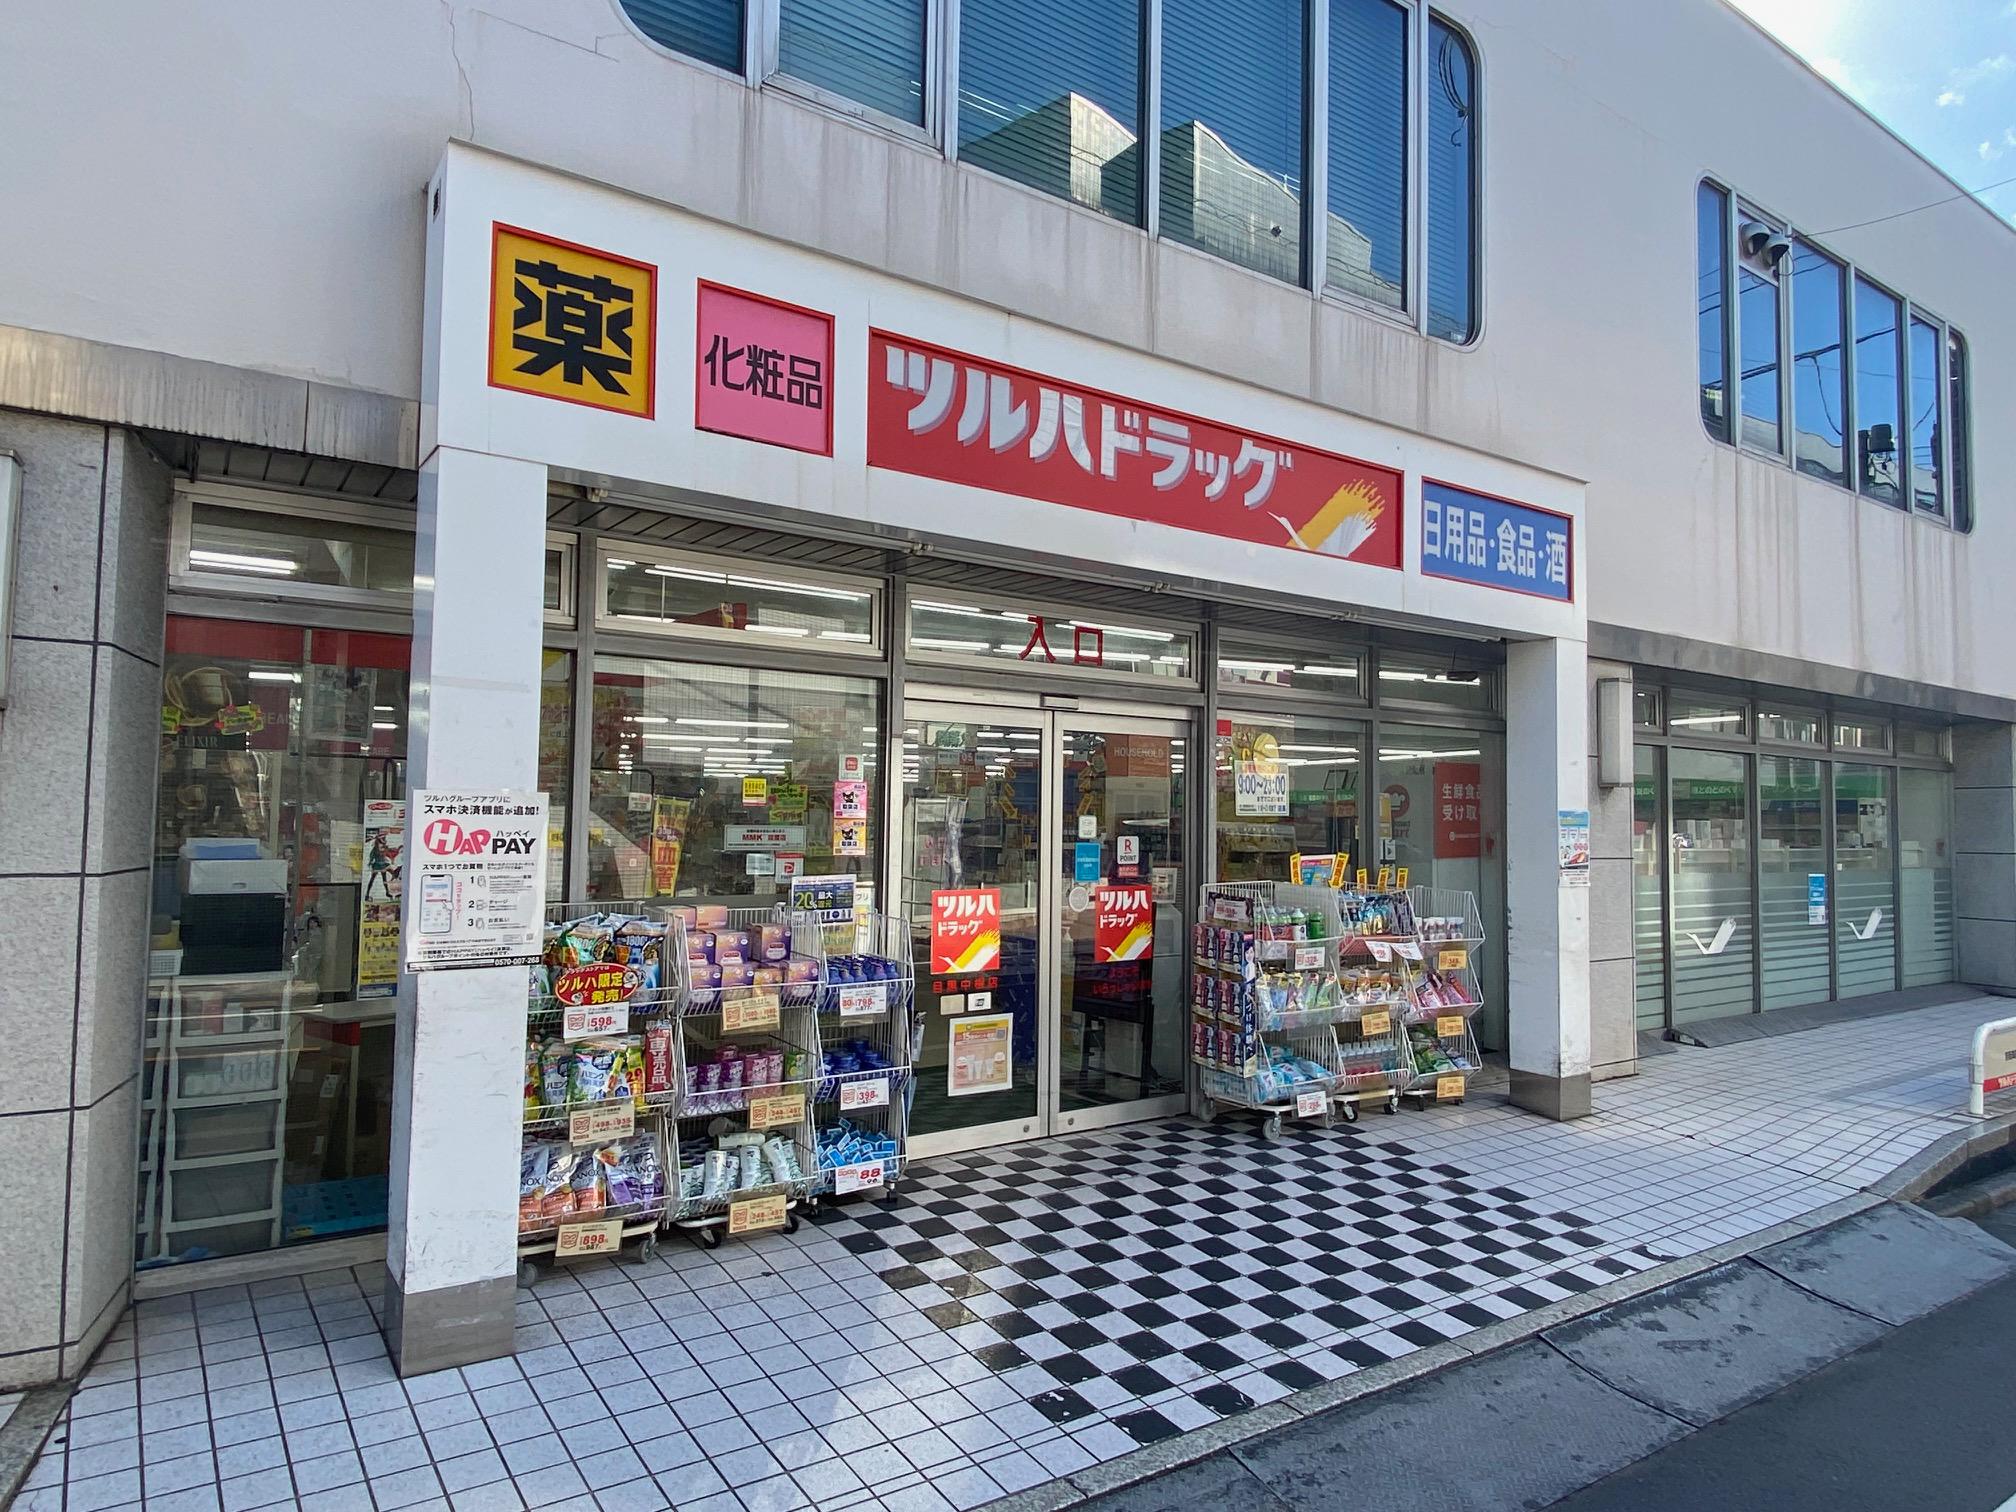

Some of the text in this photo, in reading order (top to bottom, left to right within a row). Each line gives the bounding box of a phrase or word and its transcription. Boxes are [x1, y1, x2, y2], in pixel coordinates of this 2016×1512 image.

[512, 258, 633, 396] 薬
[703, 334, 823, 410] 化粧品
[885, 345, 1294, 509] ツルハドラッグ
[1423, 500, 1567, 585] 日用品・食品・酒
[1018, 614, 1103, 667] 入口
[1114, 746, 1164, 759] HOUSEHOLD
[1124, 839, 1132, 852] R
[468, 900, 475, 908] 2
[937, 894, 996, 918] ツルハ
[1100, 890, 1149, 912] ツルハ
[467, 919, 474, 927] 3
[938, 919, 984, 936] ドラッグ
[1100, 913, 1138, 928] ドラッグ
[494, 956, 540, 966] 0570-007-268
[558, 972, 623, 994] ツルハ限定
[591, 1016, 613, 1027] 598
[649, 1037, 668, 1084] 専売品
[859, 1090, 876, 1100] 398
[860, 1168, 880, 1179] 88
[582, 1234, 605, 1246] 898
